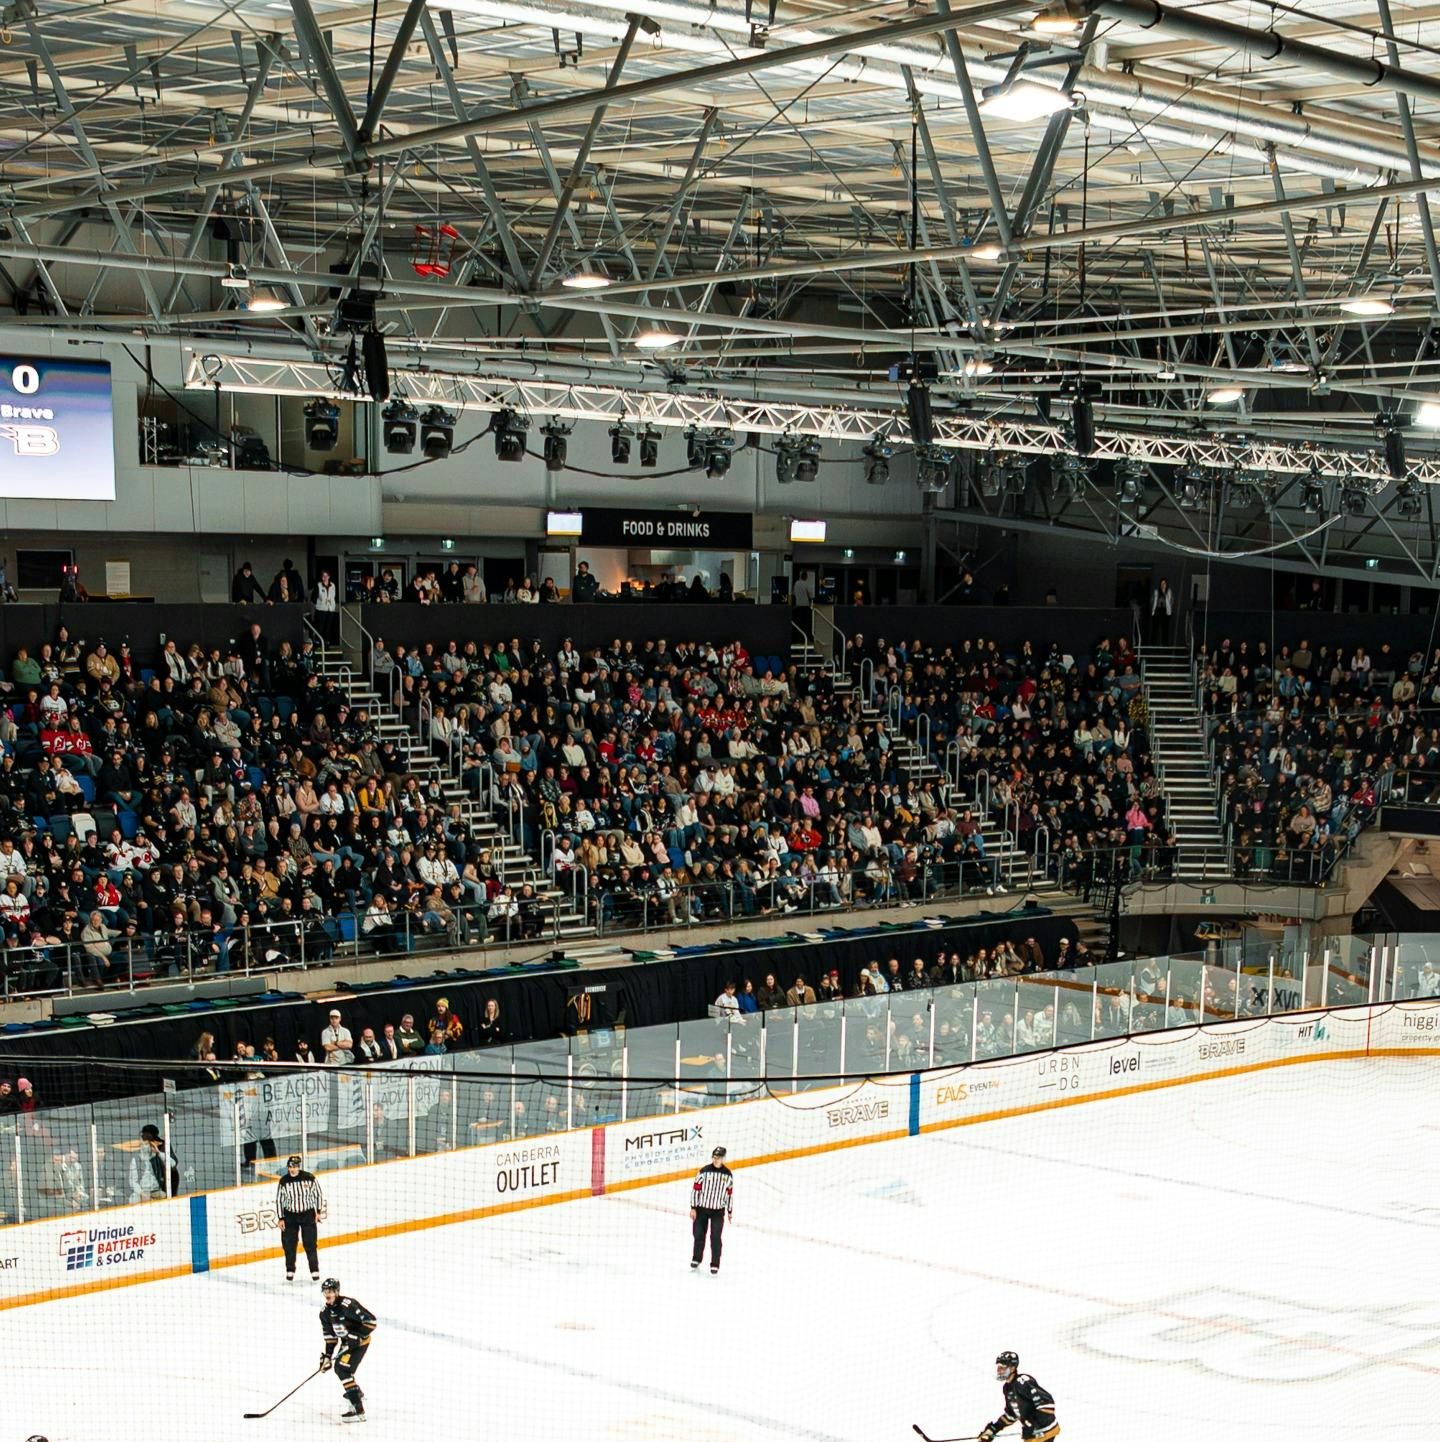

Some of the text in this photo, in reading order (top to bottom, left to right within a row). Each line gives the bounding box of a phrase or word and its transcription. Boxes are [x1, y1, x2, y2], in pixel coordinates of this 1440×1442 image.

[11, 364, 40, 394] 0
[0, 404, 54, 420] Brave
[622, 520, 710, 538] FOOD & DRINKS
[1198, 1038, 1245, 1060] BRAVE
[1038, 1055, 1080, 1075] URBN
[1110, 1051, 1141, 1075] level
[263, 1075, 327, 1103] BEACON
[265, 1102, 327, 1125] ADVISORY
[826, 1101, 889, 1128] BRAVE
[625, 1125, 704, 1151] MATRIX
[496, 1145, 560, 1167] CANBERRA
[496, 1161, 560, 1193] OUTLET
[88, 1225, 134, 1243] Unique
[97, 1233, 156, 1254] BATTERIES
[96, 1249, 144, 1267] & SOLAR
